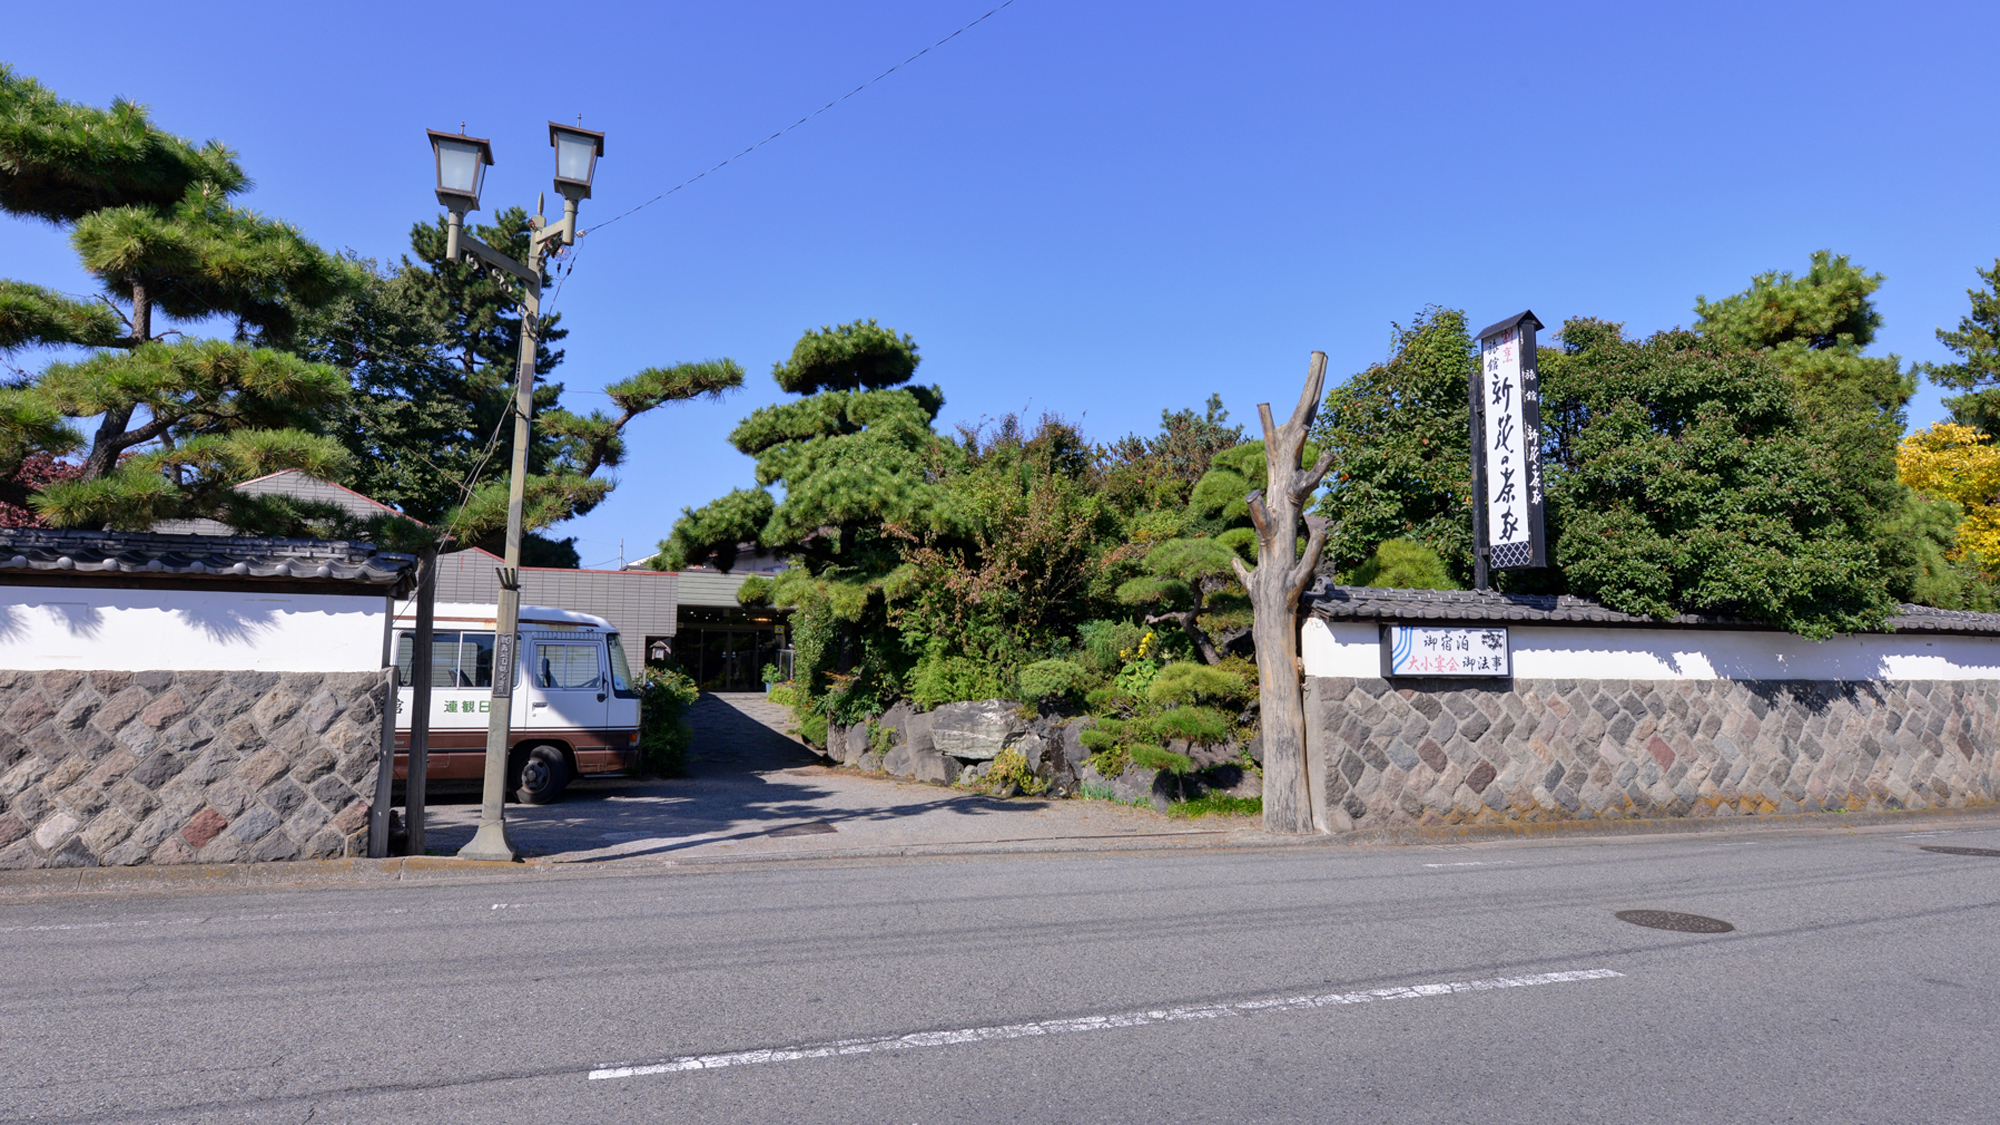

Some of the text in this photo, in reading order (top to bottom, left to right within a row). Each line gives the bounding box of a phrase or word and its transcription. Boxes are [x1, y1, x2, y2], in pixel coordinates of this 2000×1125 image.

[1487, 339, 1500, 372] 旅館
[1501, 328, 1514, 363] 割烹
[1524, 368, 1537, 401] 旅館
[1423, 634, 1469, 652] 御宿泊
[1408, 655, 1502, 673] 大小宴会 御法事
